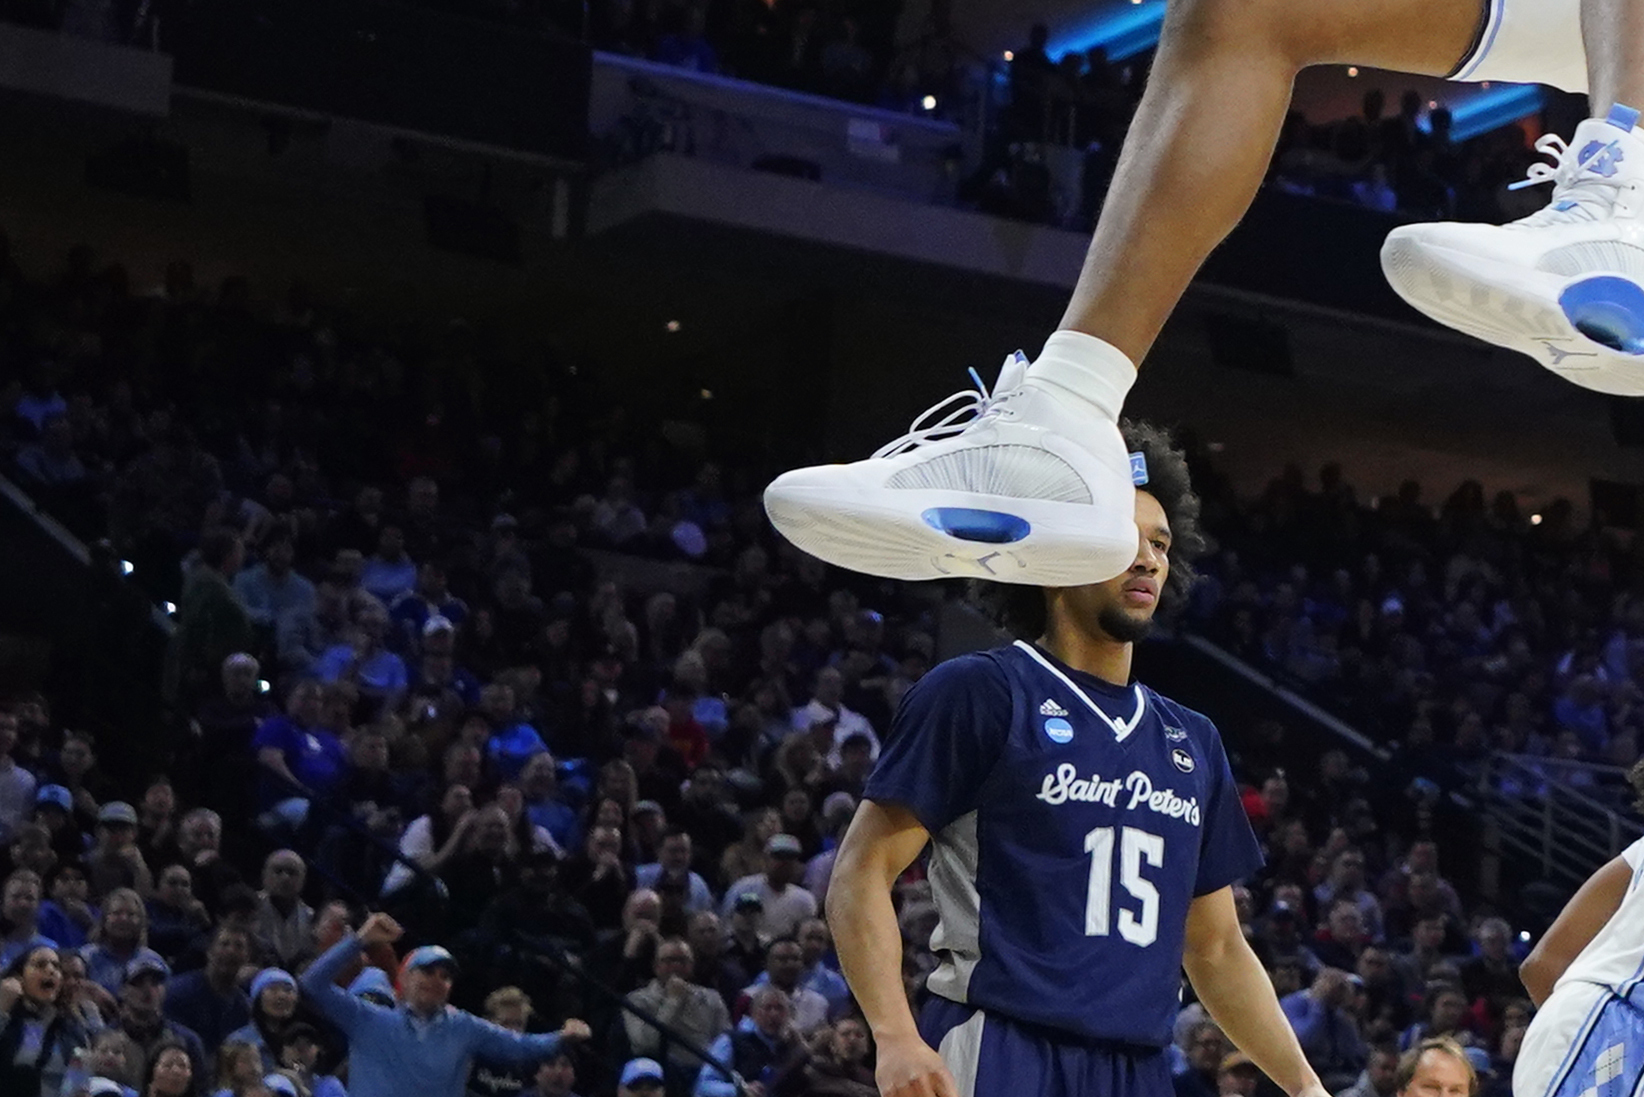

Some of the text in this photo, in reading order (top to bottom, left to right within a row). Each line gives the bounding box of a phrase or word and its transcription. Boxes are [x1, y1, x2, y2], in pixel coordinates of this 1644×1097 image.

[1036, 763, 1200, 826] Saint Peter's
[1084, 825, 1164, 948] 15
